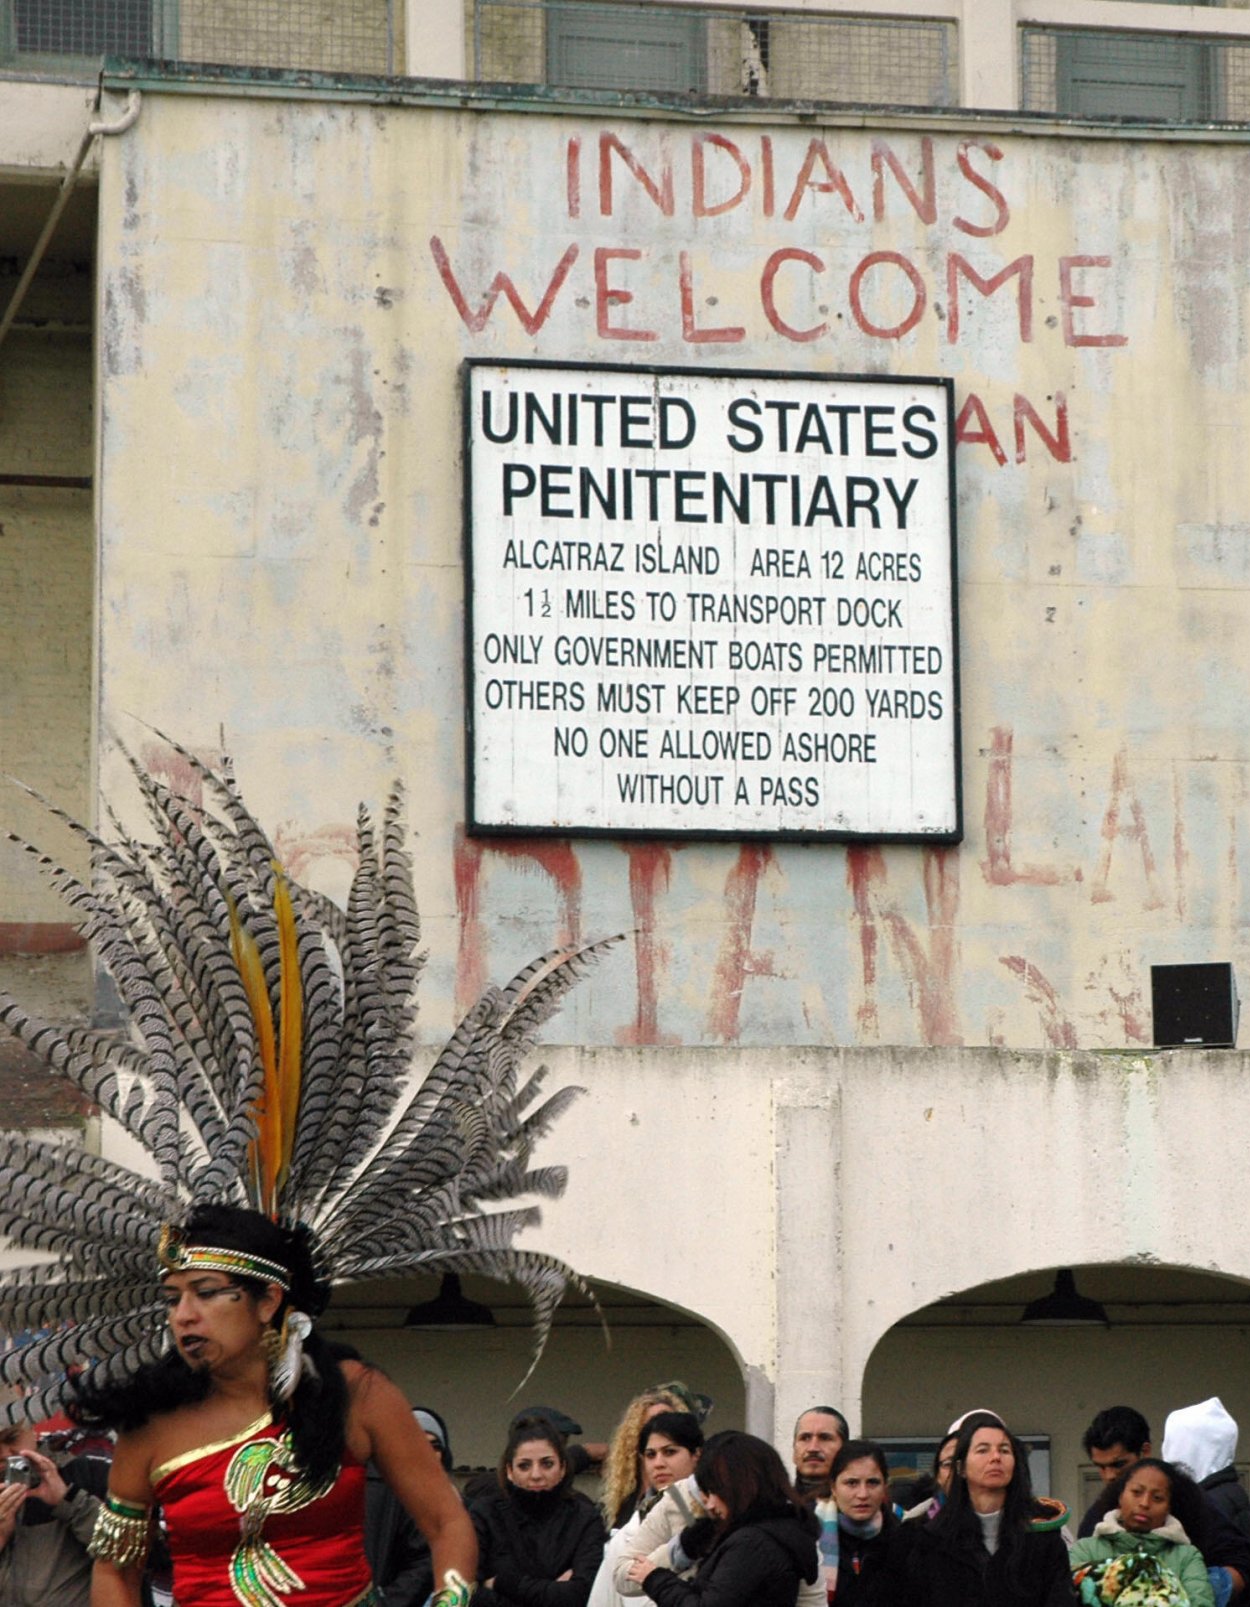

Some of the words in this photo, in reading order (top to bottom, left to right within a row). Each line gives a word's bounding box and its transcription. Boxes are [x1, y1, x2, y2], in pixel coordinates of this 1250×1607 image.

[567, 132, 1010, 237] INDIANS
[429, 236, 1129, 348] WELCOME
[481, 390, 697, 450] UNITED
[727, 398, 939, 460] STATES
[502, 463, 919, 530] PENITENTIARY
[503, 539, 624, 573] ALCATRAZ
[635, 543, 720, 576] ISLAND
[750, 548, 812, 580] AREA
[821, 550, 844, 580] 12
[856, 552, 922, 584] ACRES
[566, 589, 635, 621] MILES
[646, 591, 676, 623] TO
[687, 593, 826, 626] TRANSPORT
[837, 598, 903, 629] DOCK
[484, 633, 543, 666] ONLY
[554, 636, 718, 670] GOVERNMENT
[729, 641, 803, 673] BOATS
[814, 643, 943, 676] PERMITTED
[485, 678, 585, 713] OTHERS
[597, 683, 666, 715] MUST
[677, 685, 740, 716] KEEP
[751, 685, 797, 717] OFF
[808, 687, 855, 718] 200
[866, 689, 944, 722] YARDS
[554, 727, 588, 758] NO
[599, 727, 649, 759] ONE
[660, 729, 772, 762] ALLOWED
[782, 732, 877, 763] ASHORE
[617, 773, 724, 806] WITHOUT
[734, 777, 750, 805] A
[760, 776, 820, 807] PASS
